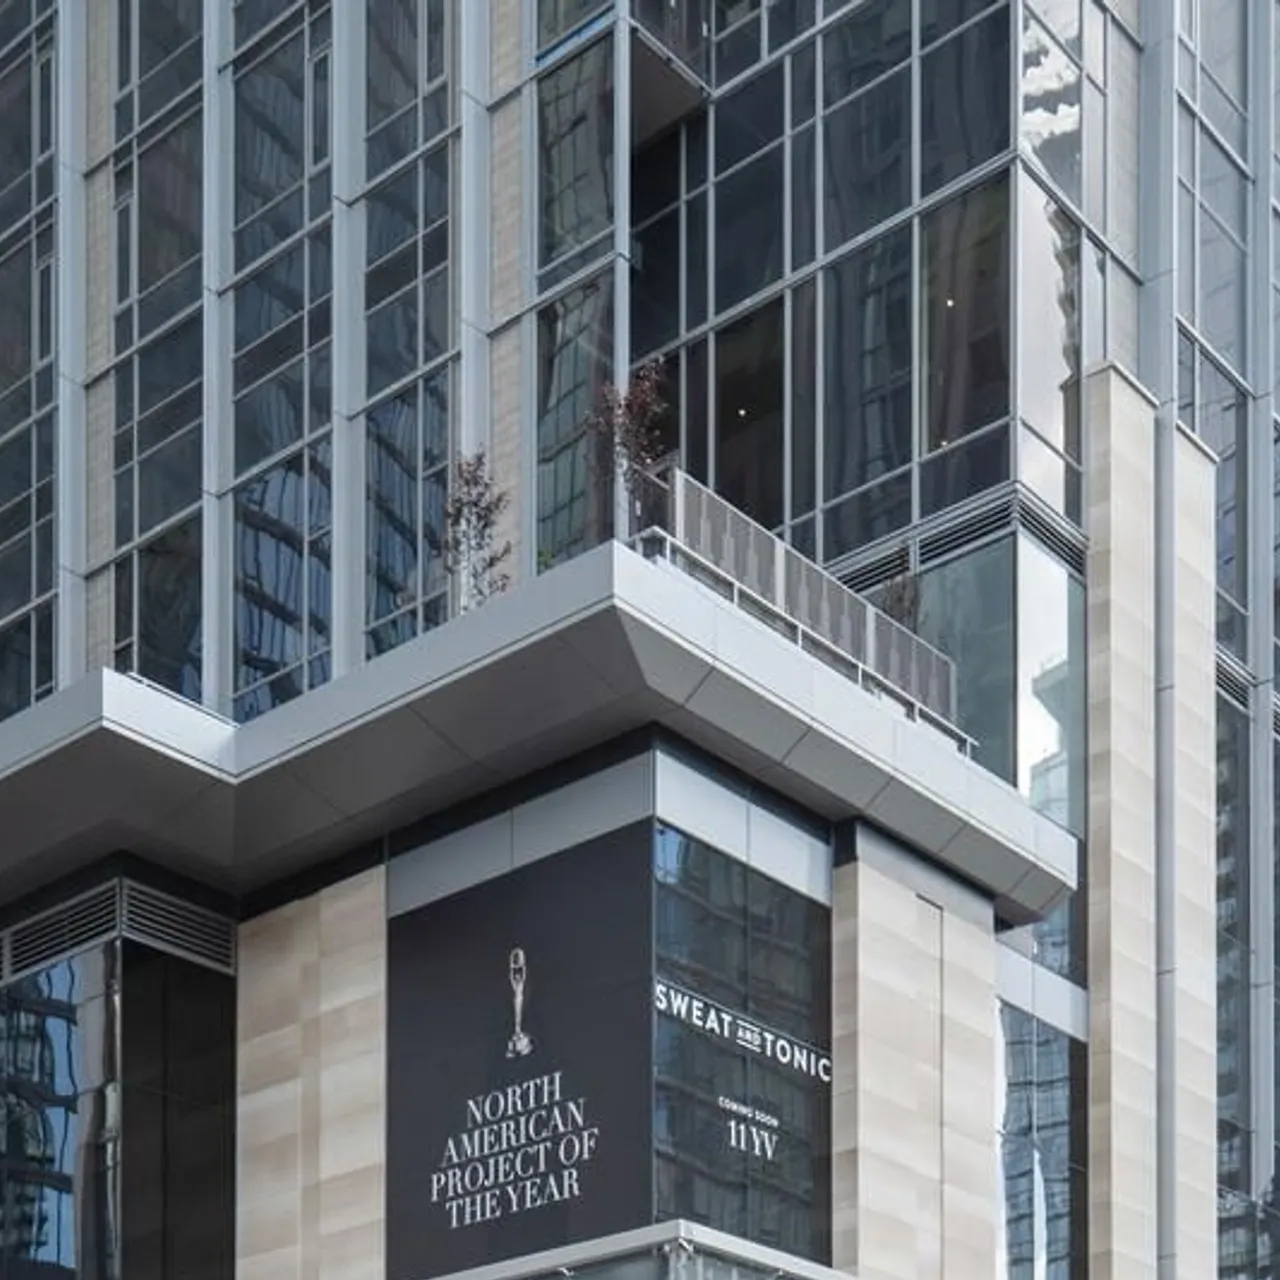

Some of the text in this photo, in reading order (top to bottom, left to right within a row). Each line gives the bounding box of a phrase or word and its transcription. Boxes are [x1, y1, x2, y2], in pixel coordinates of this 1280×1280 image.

[654, 983, 732, 1038] SWEAT
[762, 1031, 832, 1082] TONIC
[440, 1098, 587, 1168] AMERICAN
[466, 1071, 562, 1129] NORTH
[431, 1128, 599, 1202] PROJECT OF
[446, 1168, 581, 1229] THE YEAR
